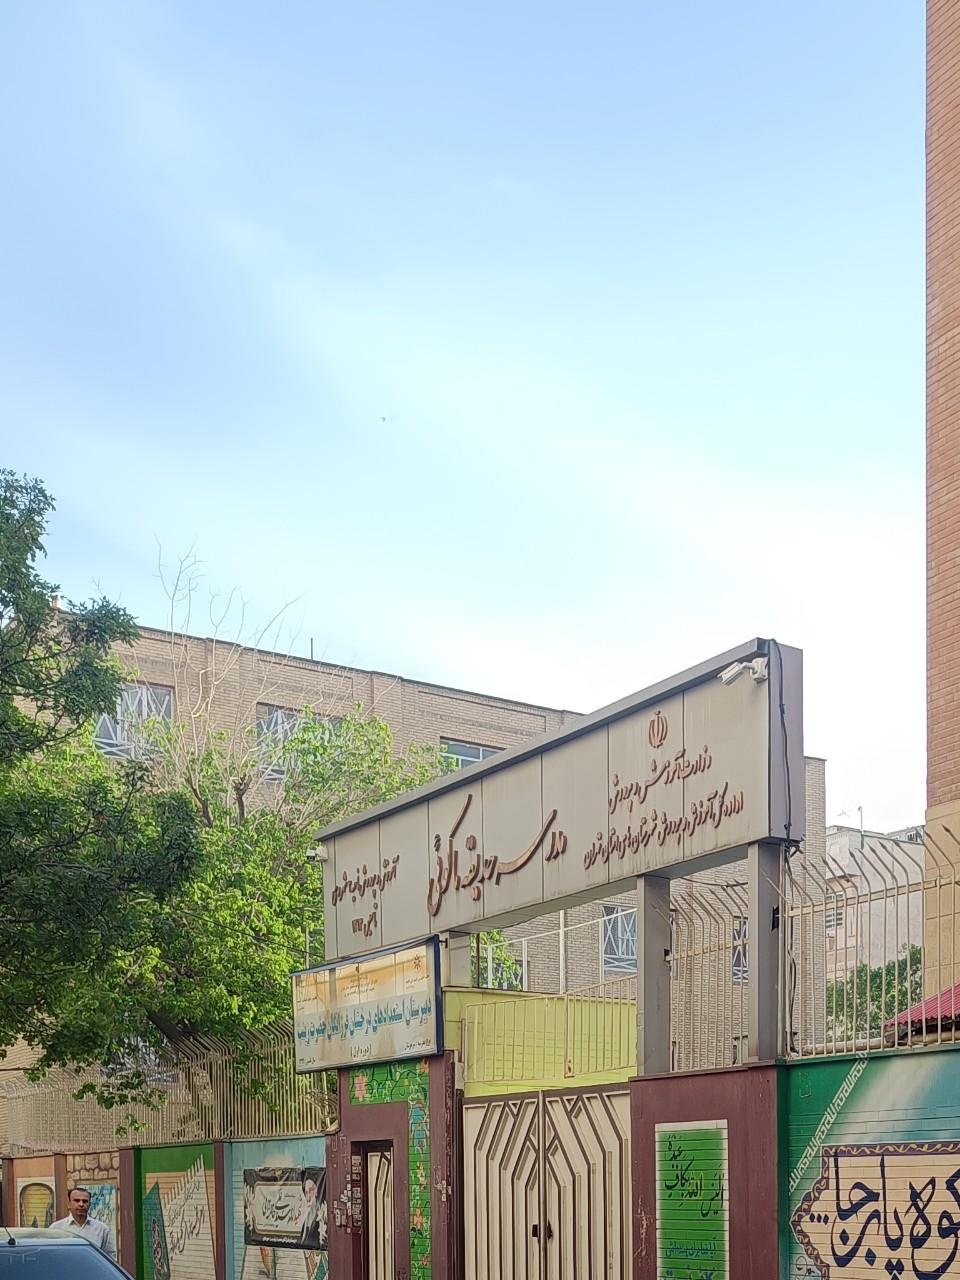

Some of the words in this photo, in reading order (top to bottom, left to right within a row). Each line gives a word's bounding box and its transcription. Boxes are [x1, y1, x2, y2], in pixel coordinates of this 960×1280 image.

[639, 748, 686, 804] آموزش
[682, 745, 712, 779] وزارت
[608, 774, 635, 815] پرورش
[689, 789, 718, 837] آموزش
[714, 782, 729, 829] کل
[724, 791, 744, 817] اداره
[495, 809, 568, 886] مدرسه
[658, 811, 684, 847] پرورش
[461, 834, 498, 902] صدیقه
[583, 832, 603, 871] تهران
[327, 1009, 350, 1041] فرزانگان
[350, 1007, 372, 1037] درخشان
[372, 1000, 405, 1033] استعدادهای
[405, 997, 432, 1027] دبیرستان
